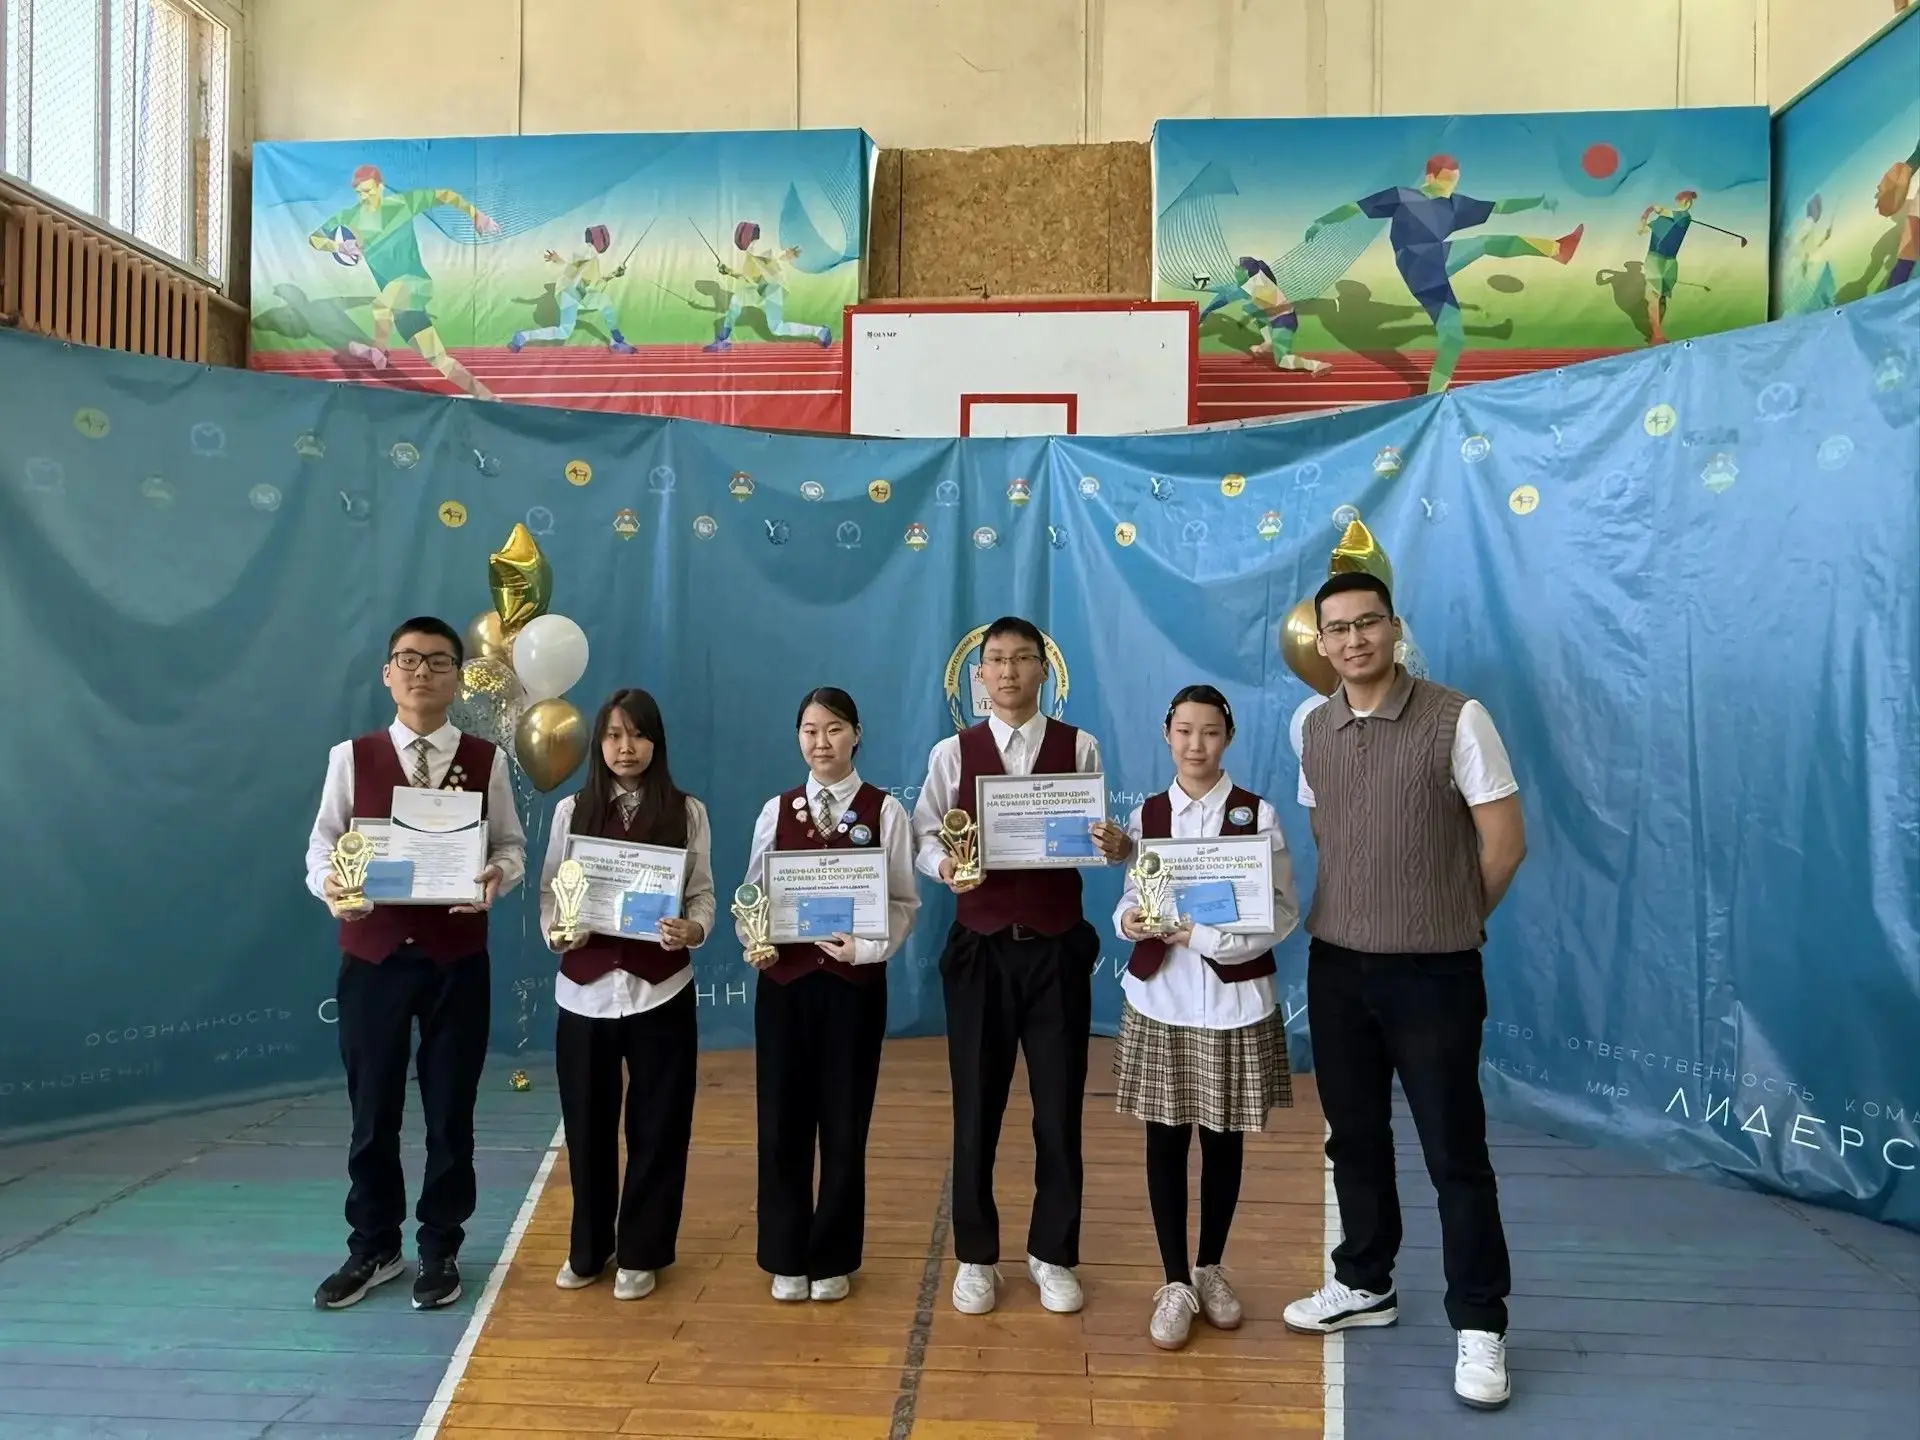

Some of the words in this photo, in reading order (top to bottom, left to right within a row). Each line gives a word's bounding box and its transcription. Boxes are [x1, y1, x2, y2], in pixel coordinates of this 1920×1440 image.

[85, 1007, 292, 1046] ОСОЗНАННОСТЬ
[1568, 1037, 1816, 1103] ОТВЕТСТВЕННОСТЬ
[1586, 1080, 1631, 1099] МИР
[1665, 1087, 1916, 1170] ЛИДЕРС
